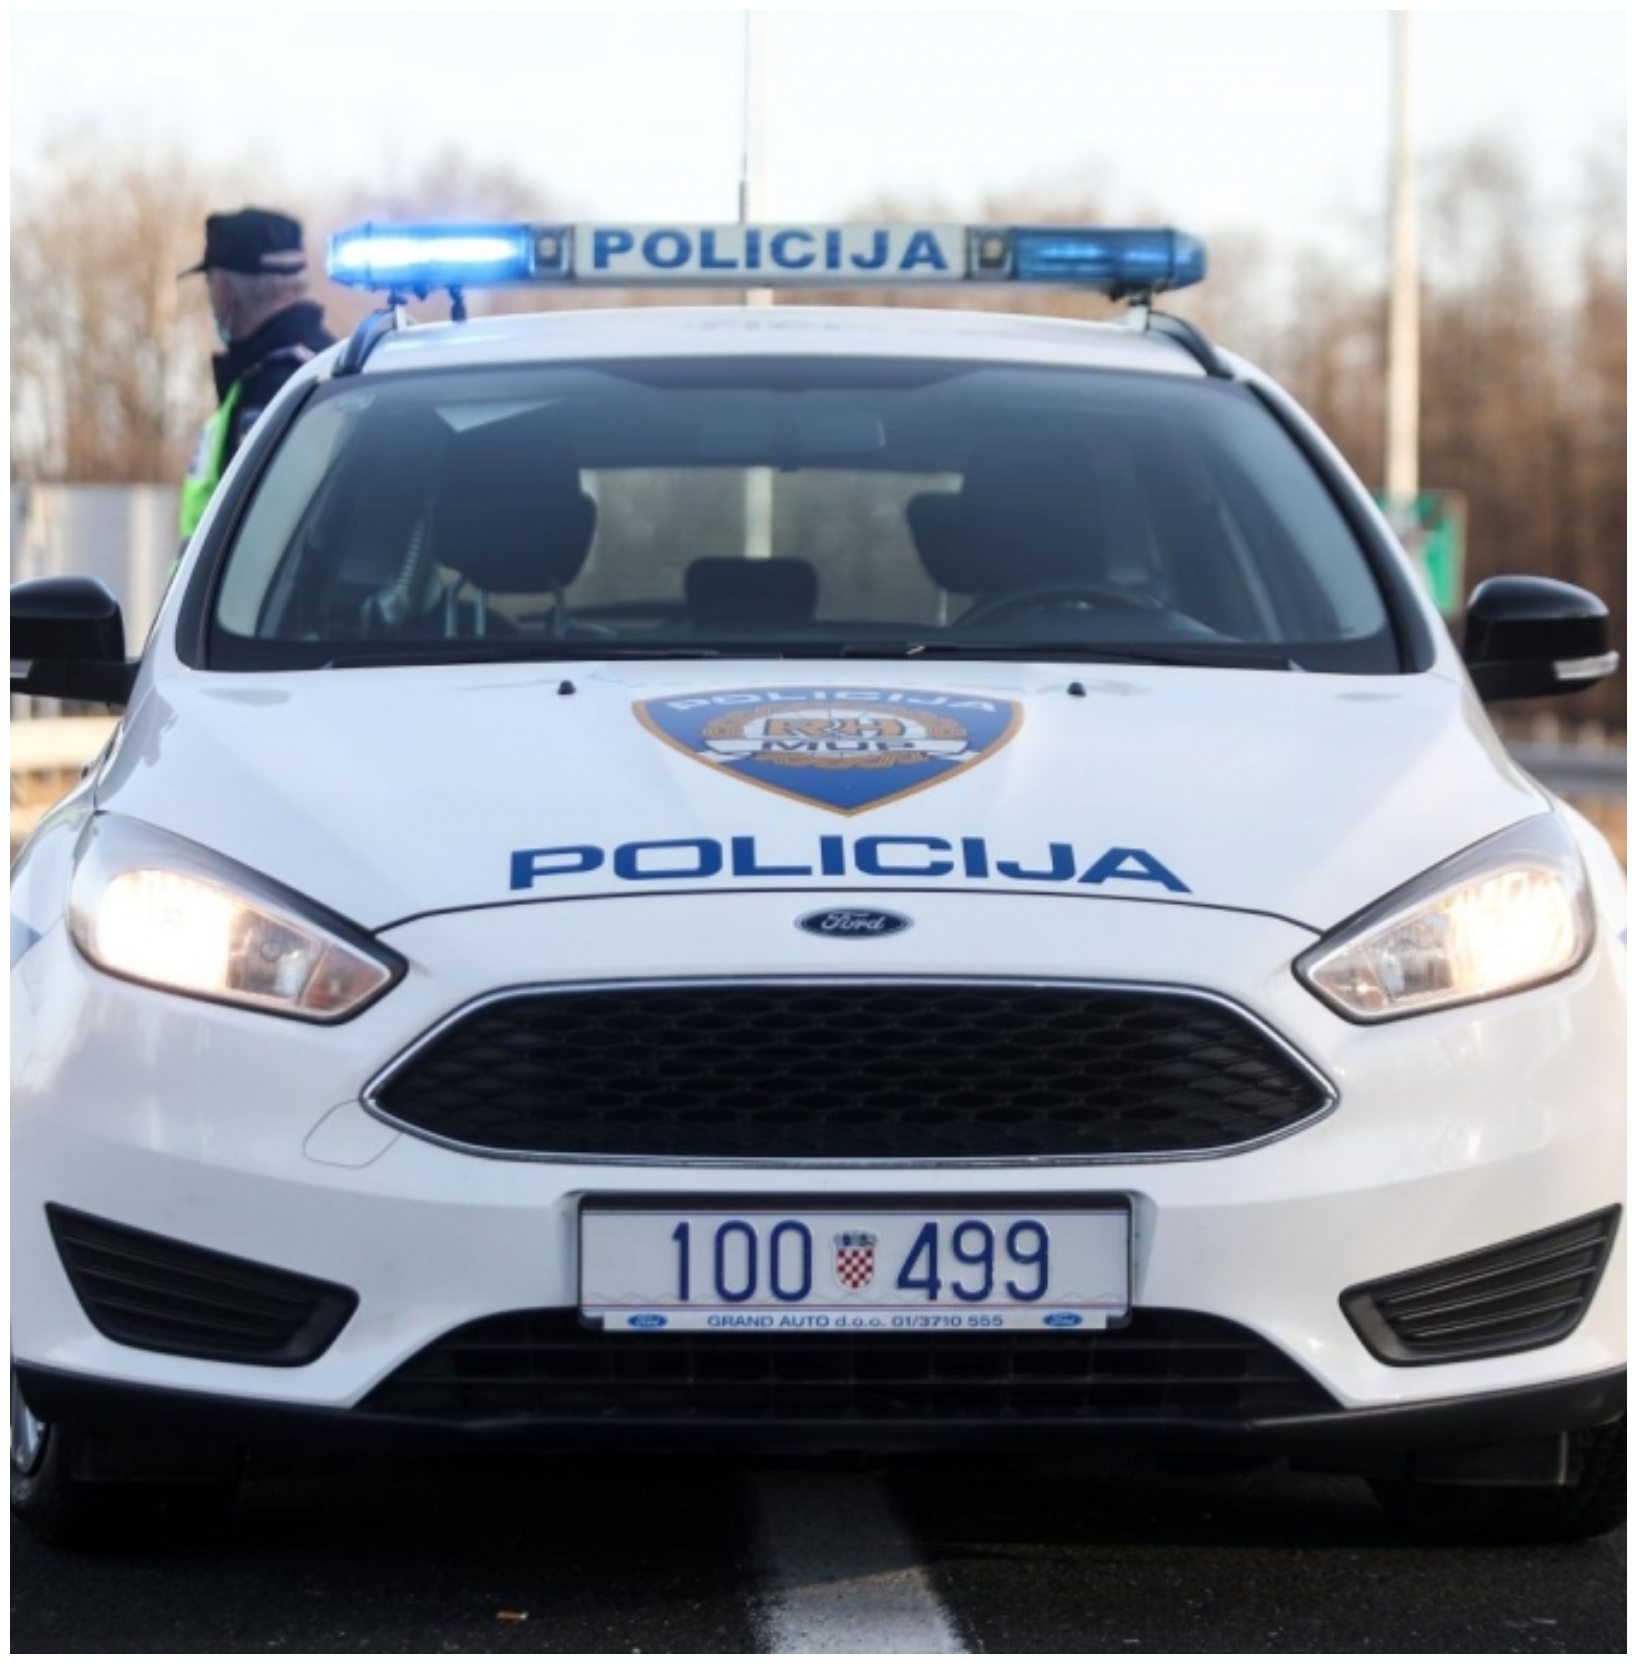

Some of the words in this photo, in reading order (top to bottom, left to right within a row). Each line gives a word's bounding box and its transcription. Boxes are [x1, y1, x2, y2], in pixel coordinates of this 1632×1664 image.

[593, 230, 948, 270] POLICIJA
[668, 689, 996, 712] POLICIJA
[763, 717, 906, 739] RH
[763, 740, 914, 752] MUP
[509, 834, 1191, 892] POLICIJA
[821, 912, 886, 931] Ford
[671, 1220, 813, 1302] 100
[895, 1220, 1049, 1302] 499
[707, 1315, 774, 1327] GRAND
[779, 1315, 830, 1327] AUTO
[834, 1314, 886, 1327] d.o.o.
[967, 1315, 1004, 1327] 555
